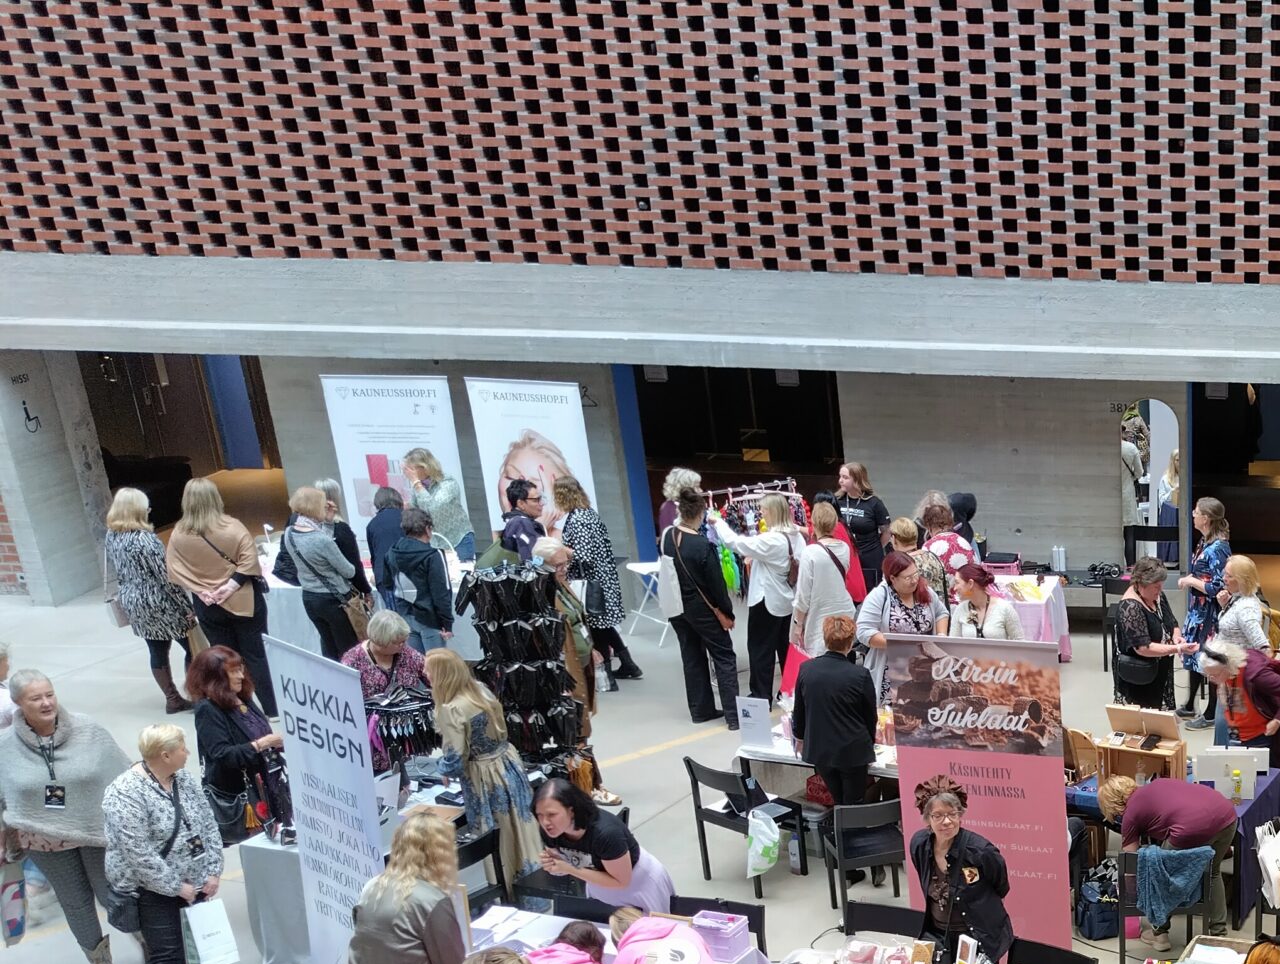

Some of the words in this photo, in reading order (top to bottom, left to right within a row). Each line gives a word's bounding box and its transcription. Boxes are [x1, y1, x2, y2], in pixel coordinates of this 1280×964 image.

[10, 373, 30, 386] HISSI
[351, 388, 437, 398] KAUNEUSSHOP.FI
[492, 391, 569, 404] KAUNEUSSHOP.FI
[931, 655, 1019, 685] Kirsin
[280, 673, 358, 729] KUKKIA
[927, 703, 1030, 733] Suklaat
[283, 710, 365, 768] DESIGN
[949, 761, 1012, 780] KÄSINTEHTY
[961, 783, 1026, 799] ENLINNASSA
[961, 819, 1043, 831] IRSINSUKLAAT.FI
[337, 830, 360, 853] JOKA
[1011, 843, 1055, 854] SUKLAAT
